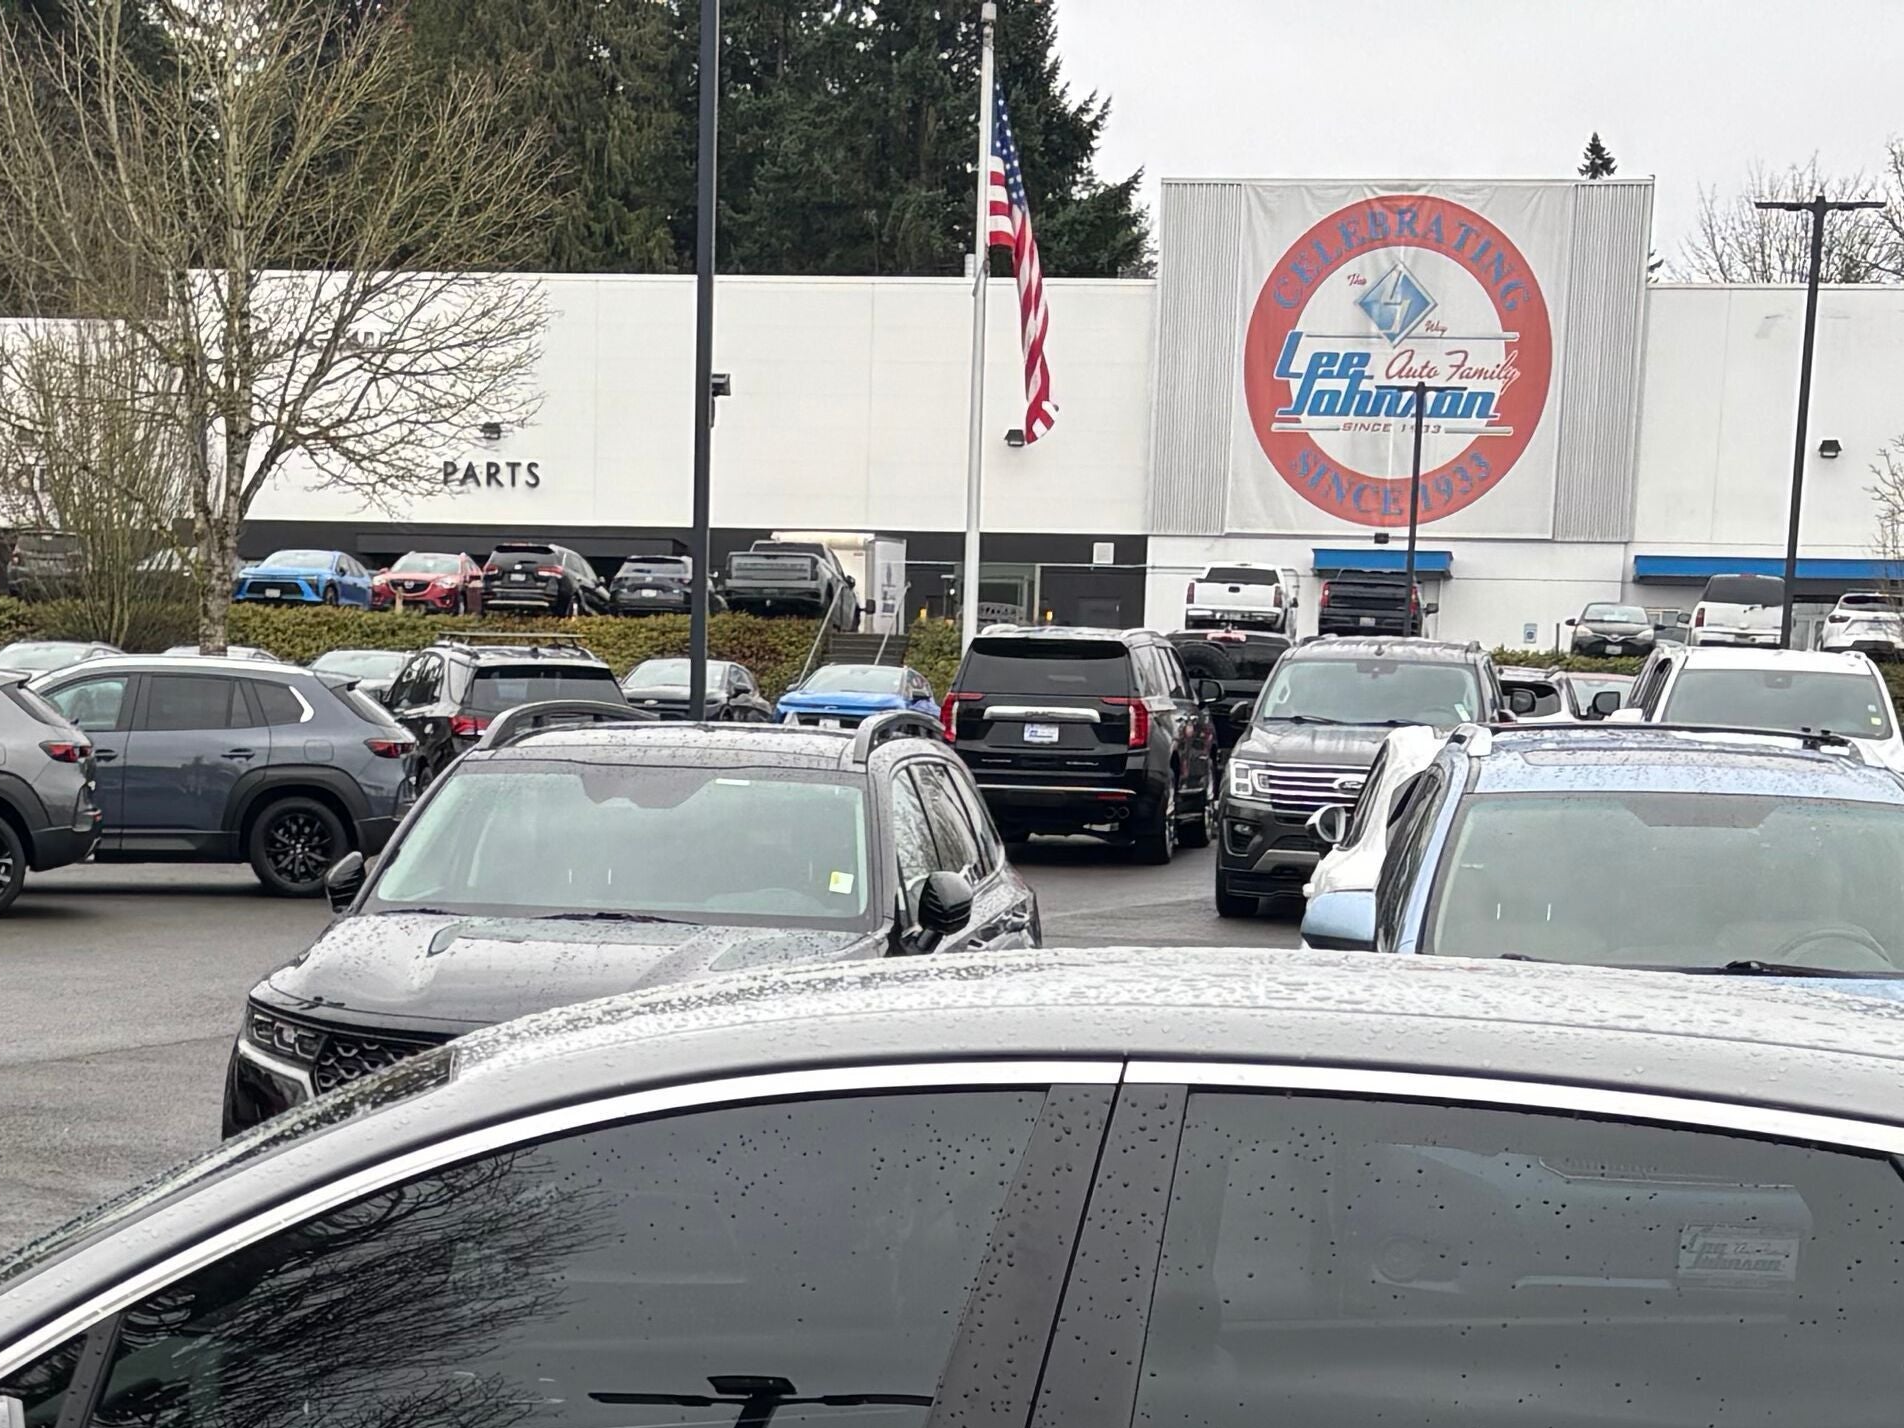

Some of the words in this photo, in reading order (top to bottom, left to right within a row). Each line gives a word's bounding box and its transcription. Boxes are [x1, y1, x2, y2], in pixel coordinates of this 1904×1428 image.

[1272, 205, 1530, 312] CELEBRATING
[1273, 330, 1375, 381] Lee
[1384, 349, 1440, 381] Auto
[1445, 349, 1521, 395] Family
[1341, 422, 1392, 433] SINCE
[443, 461, 540, 488] PARTS
[1289, 447, 1403, 516] SINCE
[1419, 450, 1493, 511] 1933
